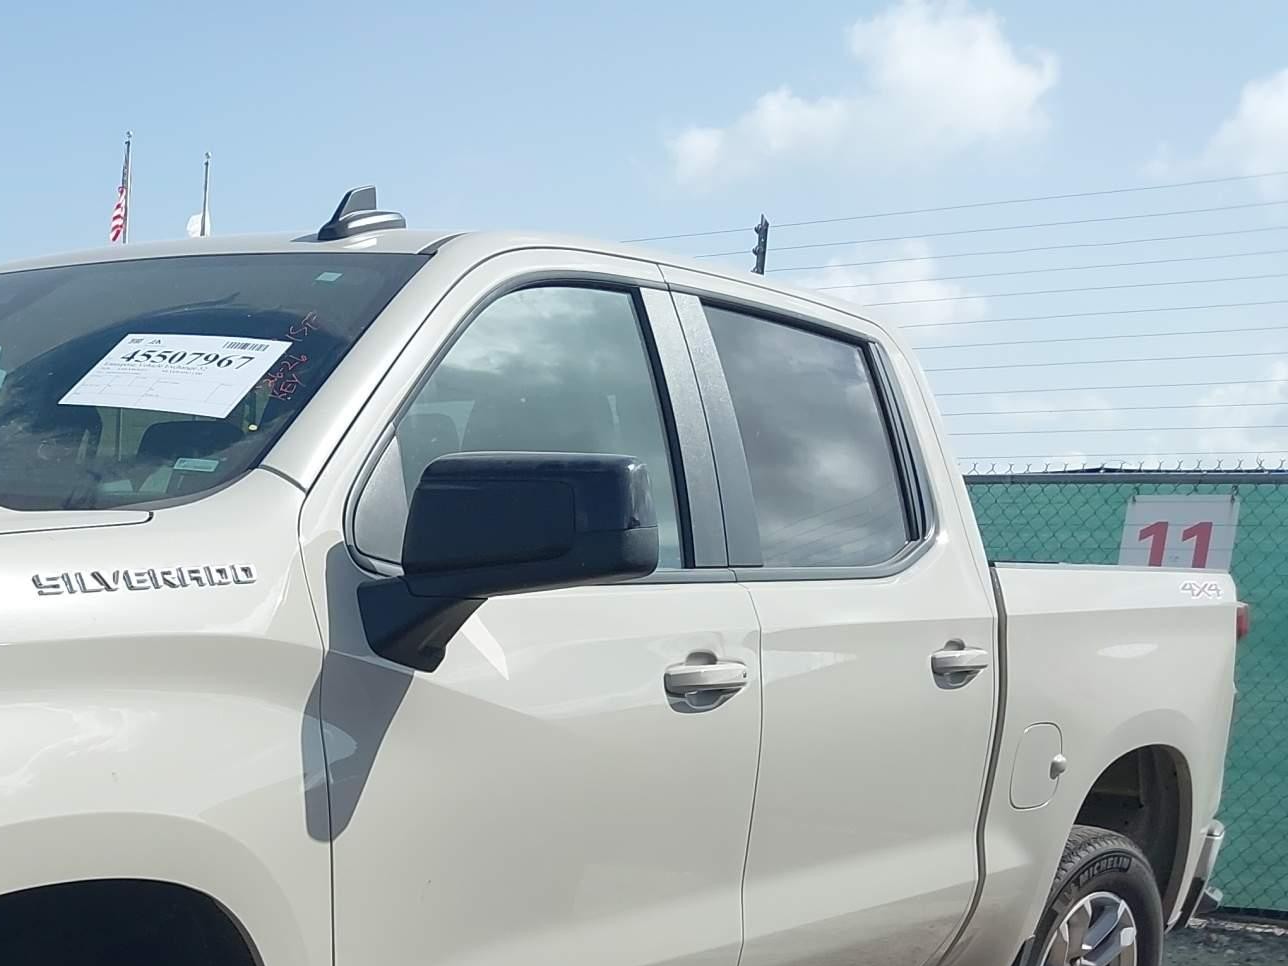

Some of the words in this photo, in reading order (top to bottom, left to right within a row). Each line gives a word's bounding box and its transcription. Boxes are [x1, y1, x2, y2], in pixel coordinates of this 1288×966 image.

[121, 349, 255, 370] 45507967
[1138, 521, 1213, 568] 11
[31, 564, 257, 595] SILVERADO
[1078, 855, 1131, 887] MICHELIN
